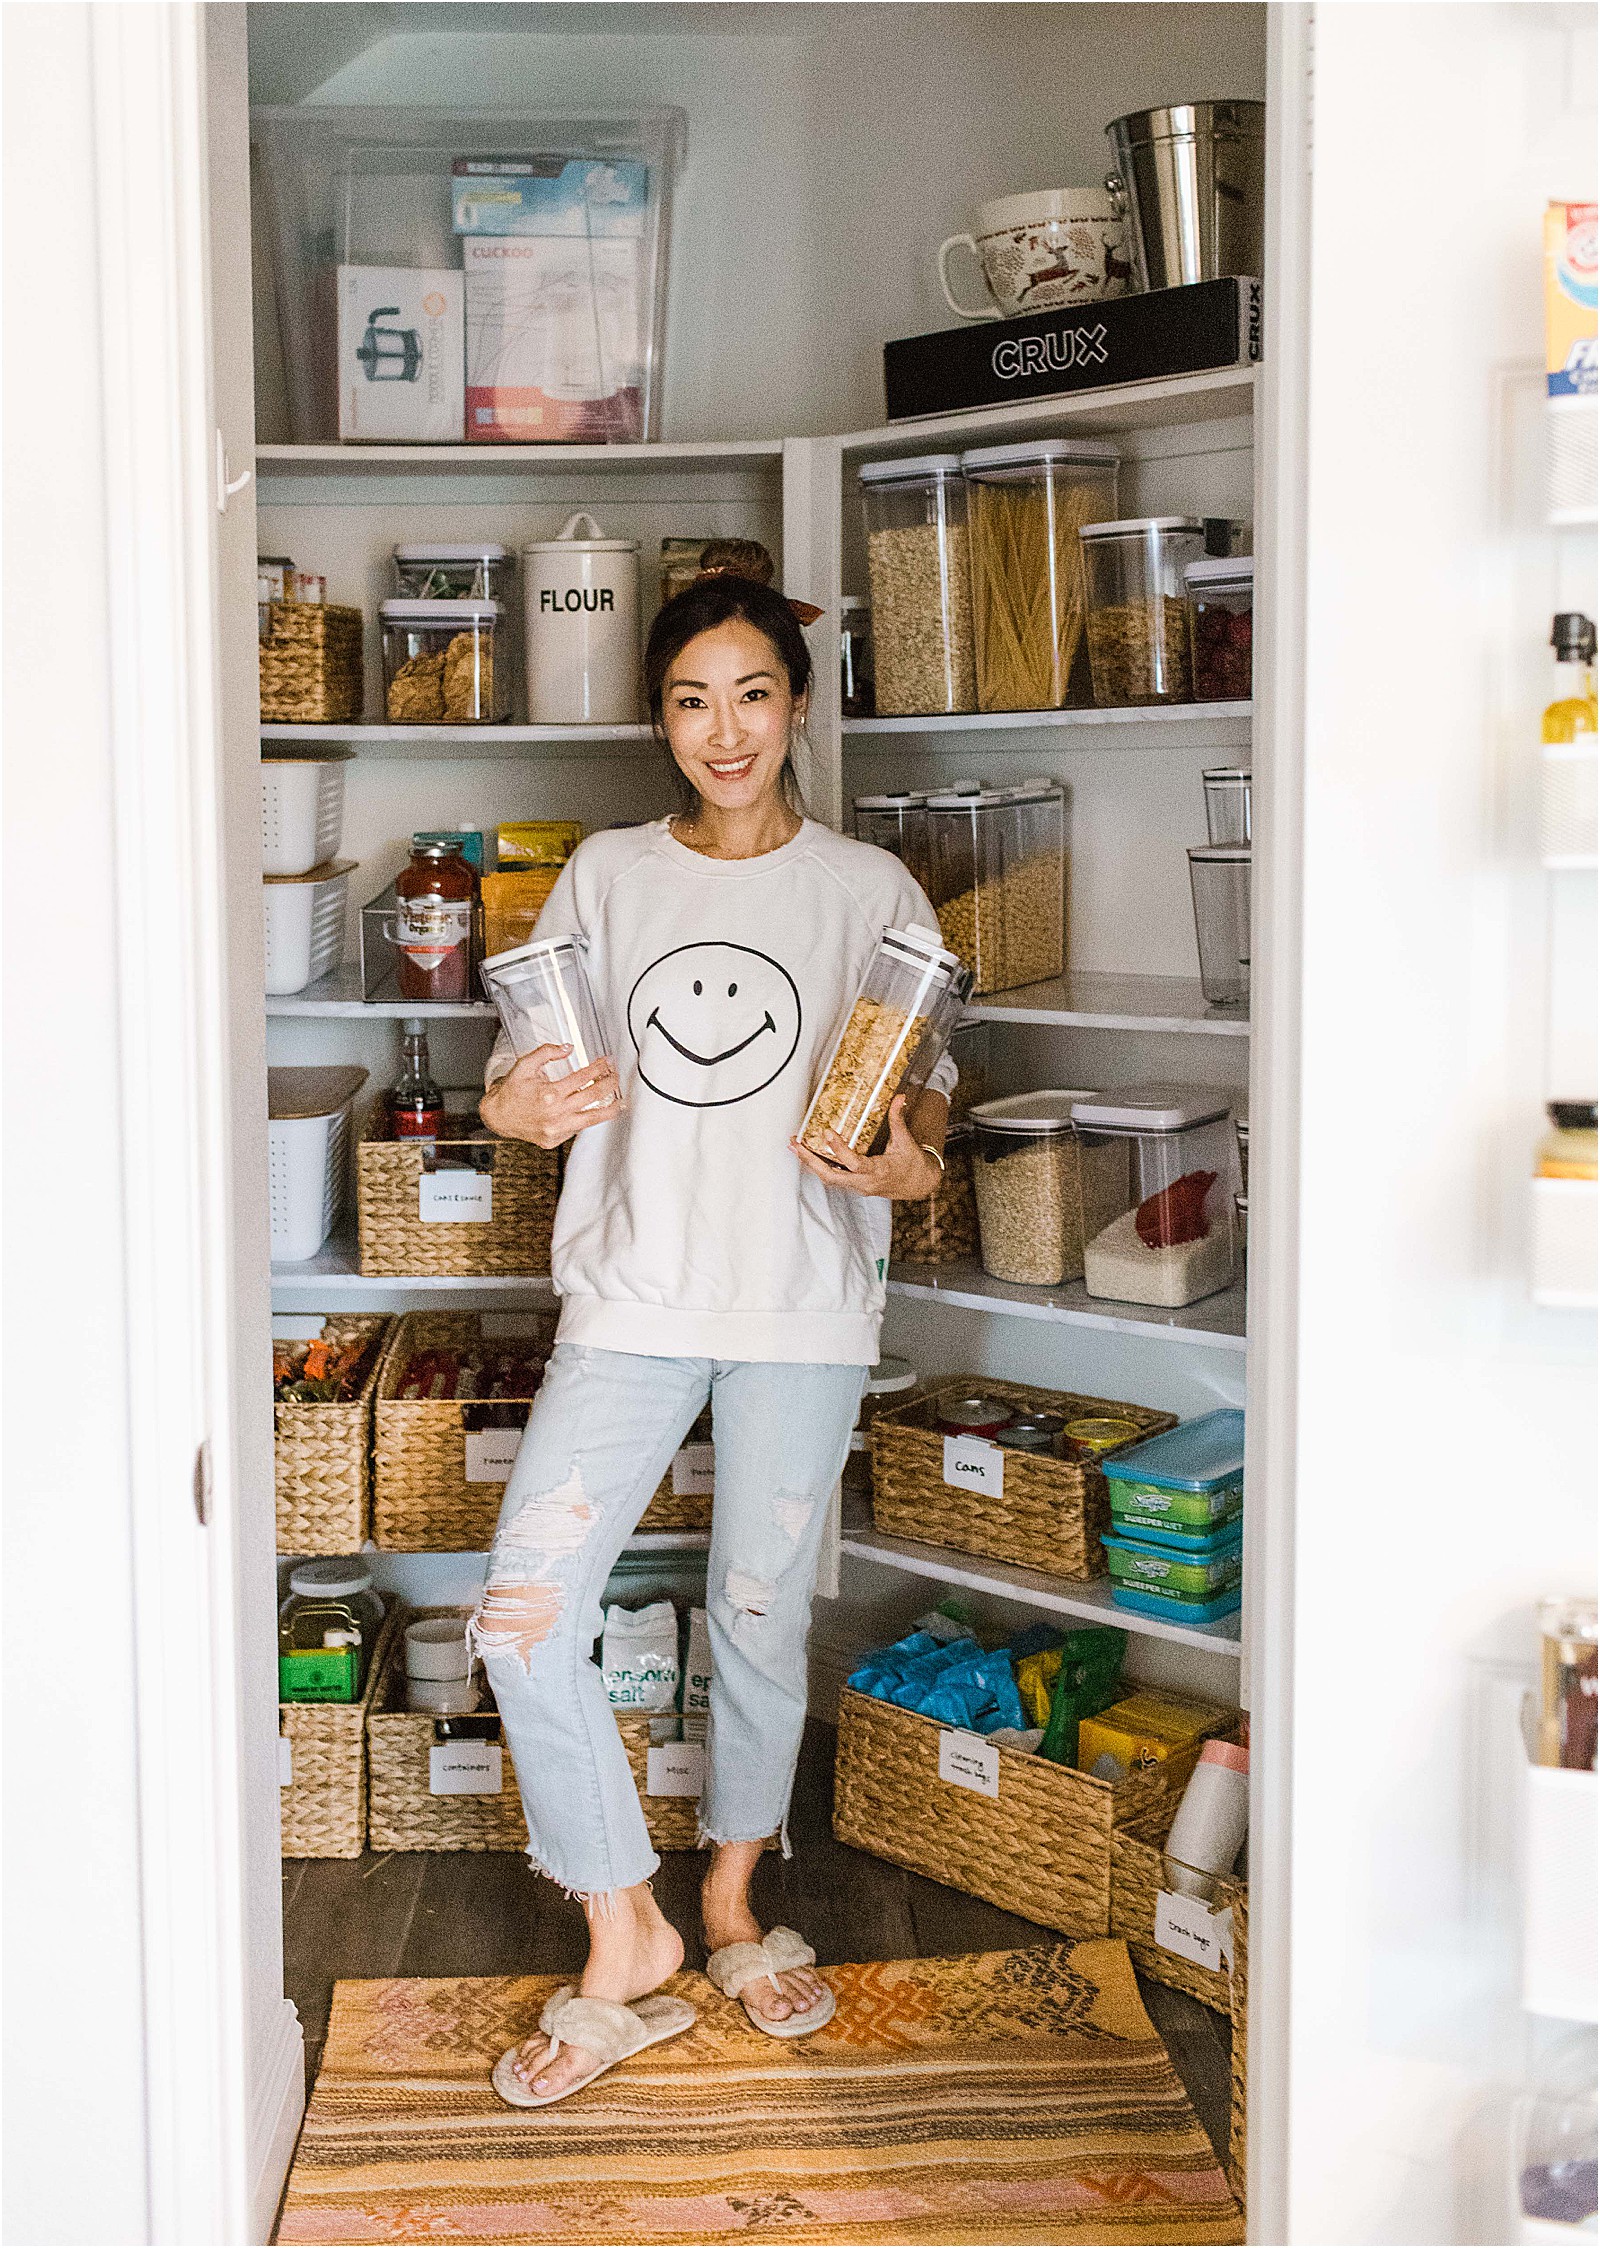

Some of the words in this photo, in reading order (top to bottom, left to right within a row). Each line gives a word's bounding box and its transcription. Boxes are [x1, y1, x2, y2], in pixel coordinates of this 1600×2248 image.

[472, 247, 533, 259] CUCKOO
[1248, 283, 1261, 361] CRUX
[992, 322, 1109, 380] CRUX
[540, 588, 614, 612] FLOUR
[1123, 1513, 1162, 1527] SWEEPER
[1163, 1521, 1183, 1531] WET
[1122, 1578, 1161, 1593] SWEEPER
[608, 1685, 645, 1702] salt
